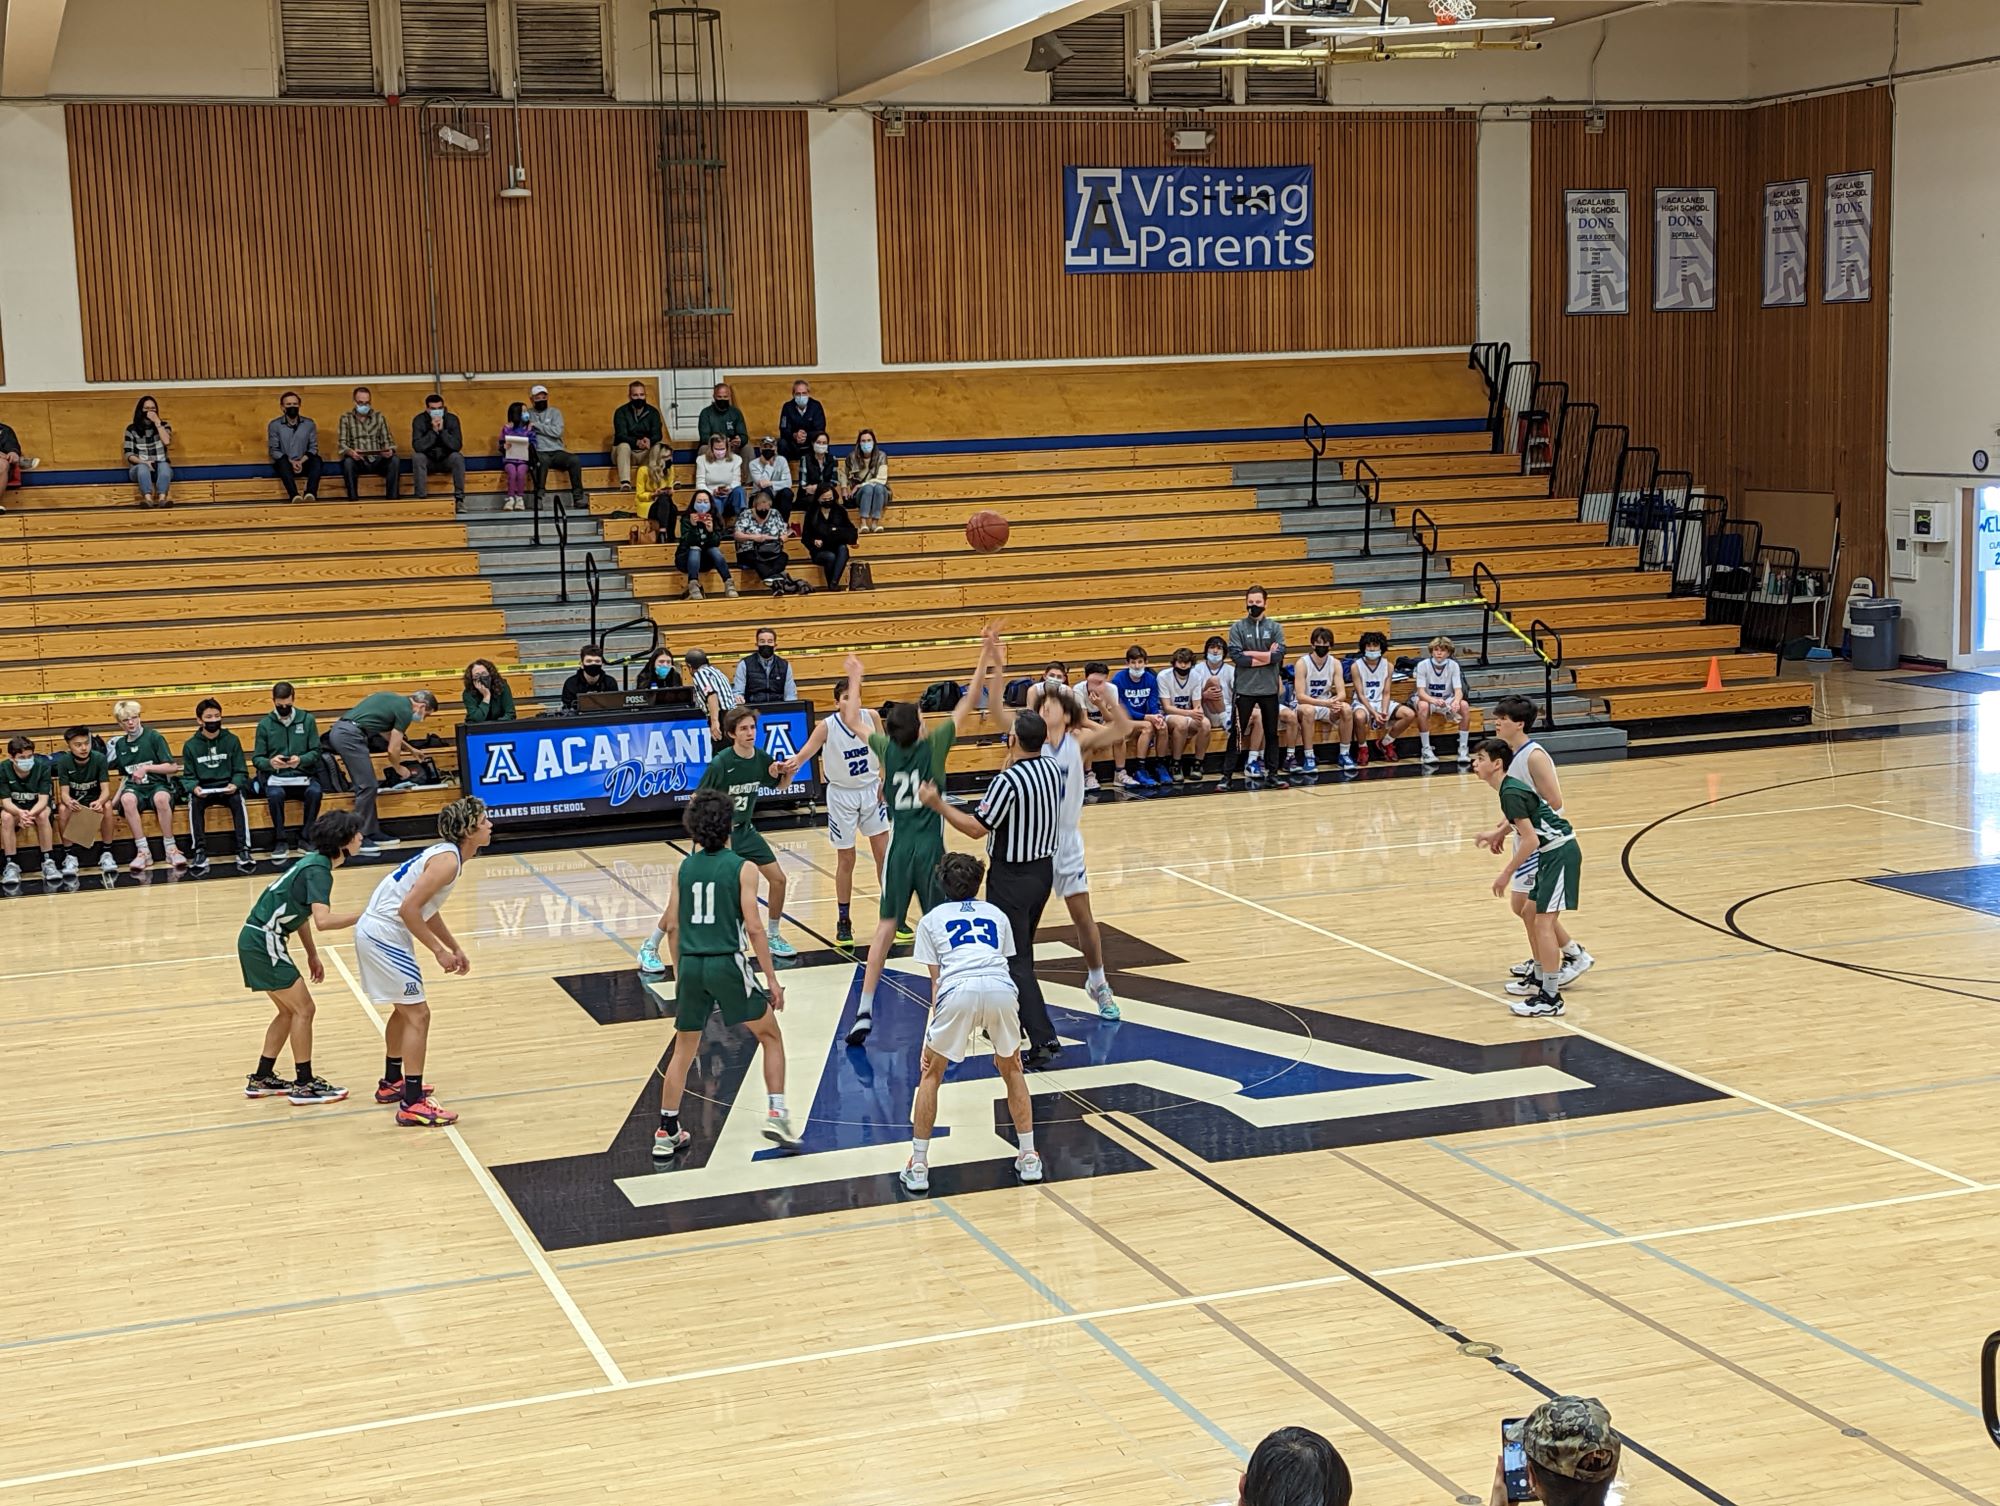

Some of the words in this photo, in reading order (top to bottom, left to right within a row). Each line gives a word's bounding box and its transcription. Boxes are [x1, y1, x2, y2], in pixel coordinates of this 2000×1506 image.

[1131, 175, 1308, 226] Visiting
[1836, 201, 1862, 214] DONS
[1579, 217, 1614, 229] DONS
[1668, 216, 1703, 227] DONS
[1774, 209, 1798, 221] DONS
[1140, 226, 1314, 267] Parents
[843, 746, 869, 760] DONS
[480, 743, 526, 784] A
[849, 759, 869, 776] 22
[604, 759, 688, 807] Dons
[892, 769, 922, 811] 21
[530, 805, 552, 815] HIGH
[553, 803, 586, 814] SCHOOL
[734, 796, 748, 812] 23
[691, 882, 715, 924] 11
[945, 918, 999, 950] 23
